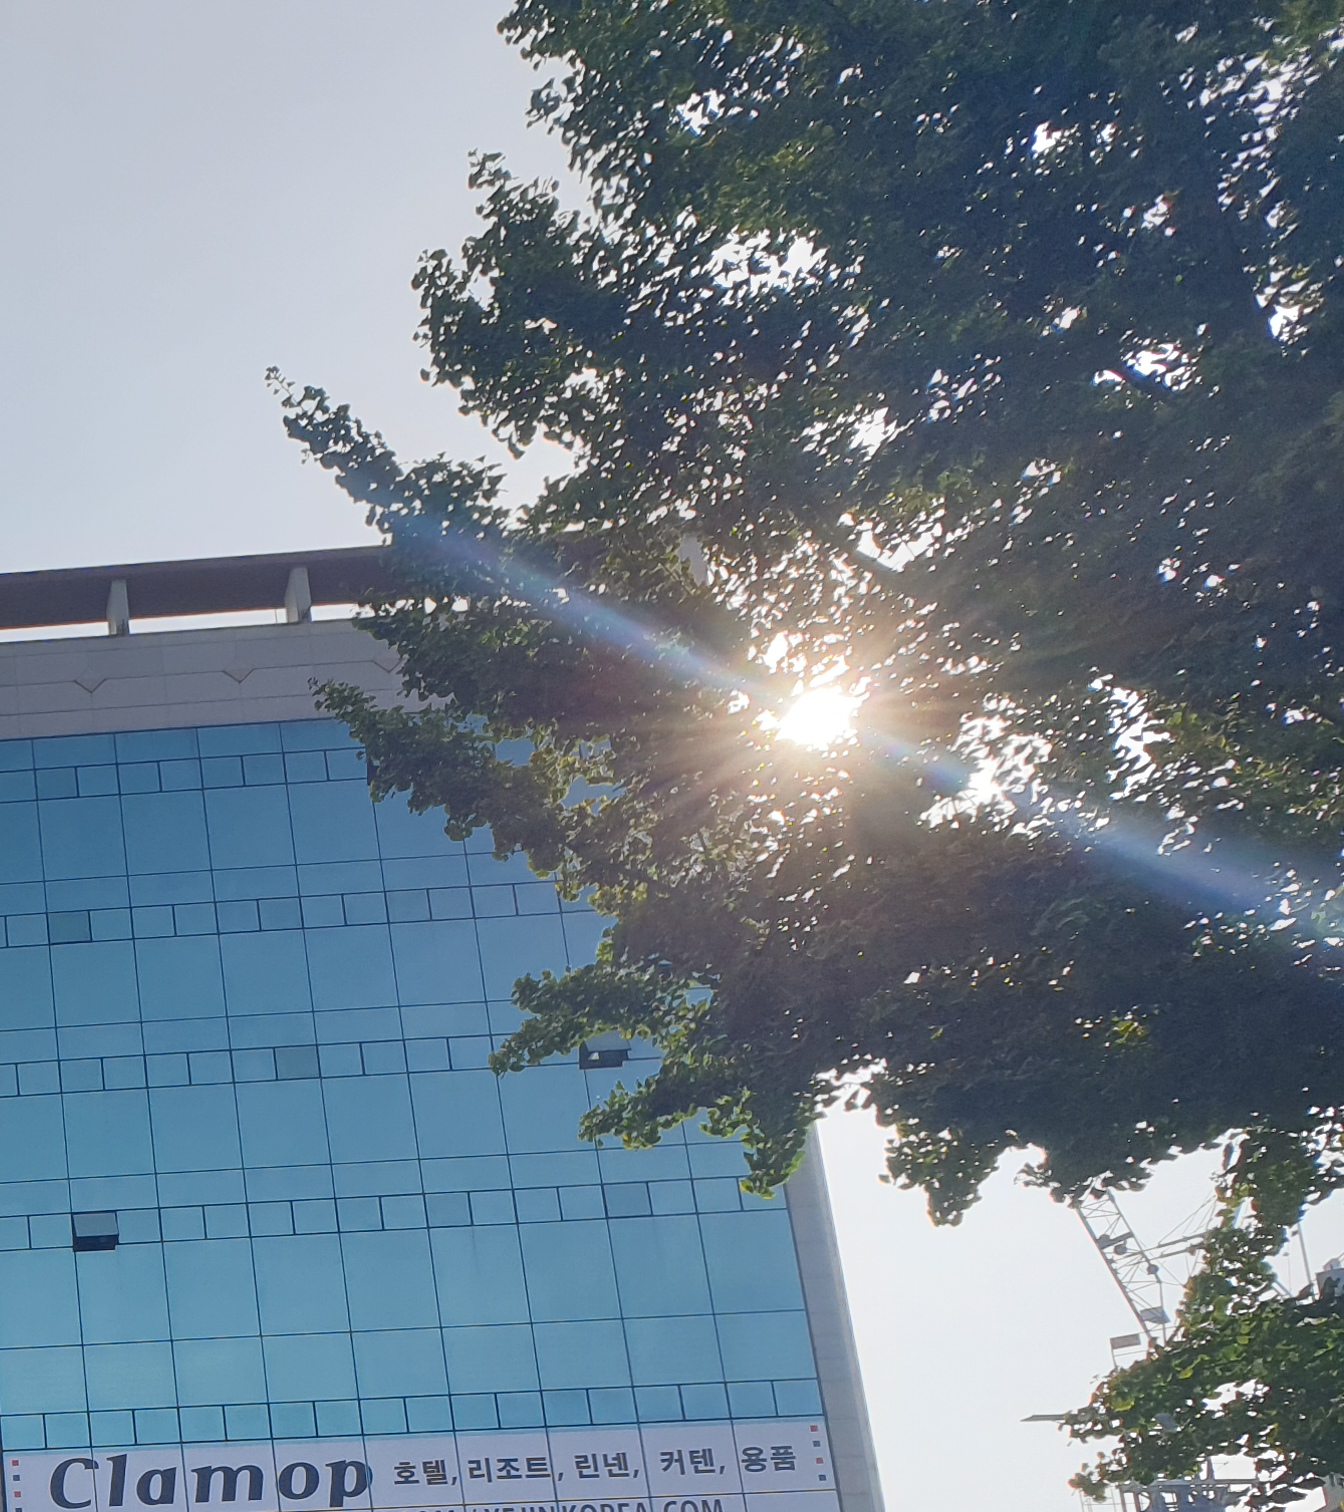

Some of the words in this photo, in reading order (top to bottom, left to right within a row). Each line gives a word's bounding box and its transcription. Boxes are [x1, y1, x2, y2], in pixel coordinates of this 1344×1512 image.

[49, 1453, 373, 1509] Clamop
[393, 1458, 459, 1487] 호텔,
[468, 1455, 565, 1484] 리조트,
[574, 1452, 640, 1480] 린넨,
[659, 1447, 726, 1477] 커텐,
[740, 1445, 797, 1472] 용품
